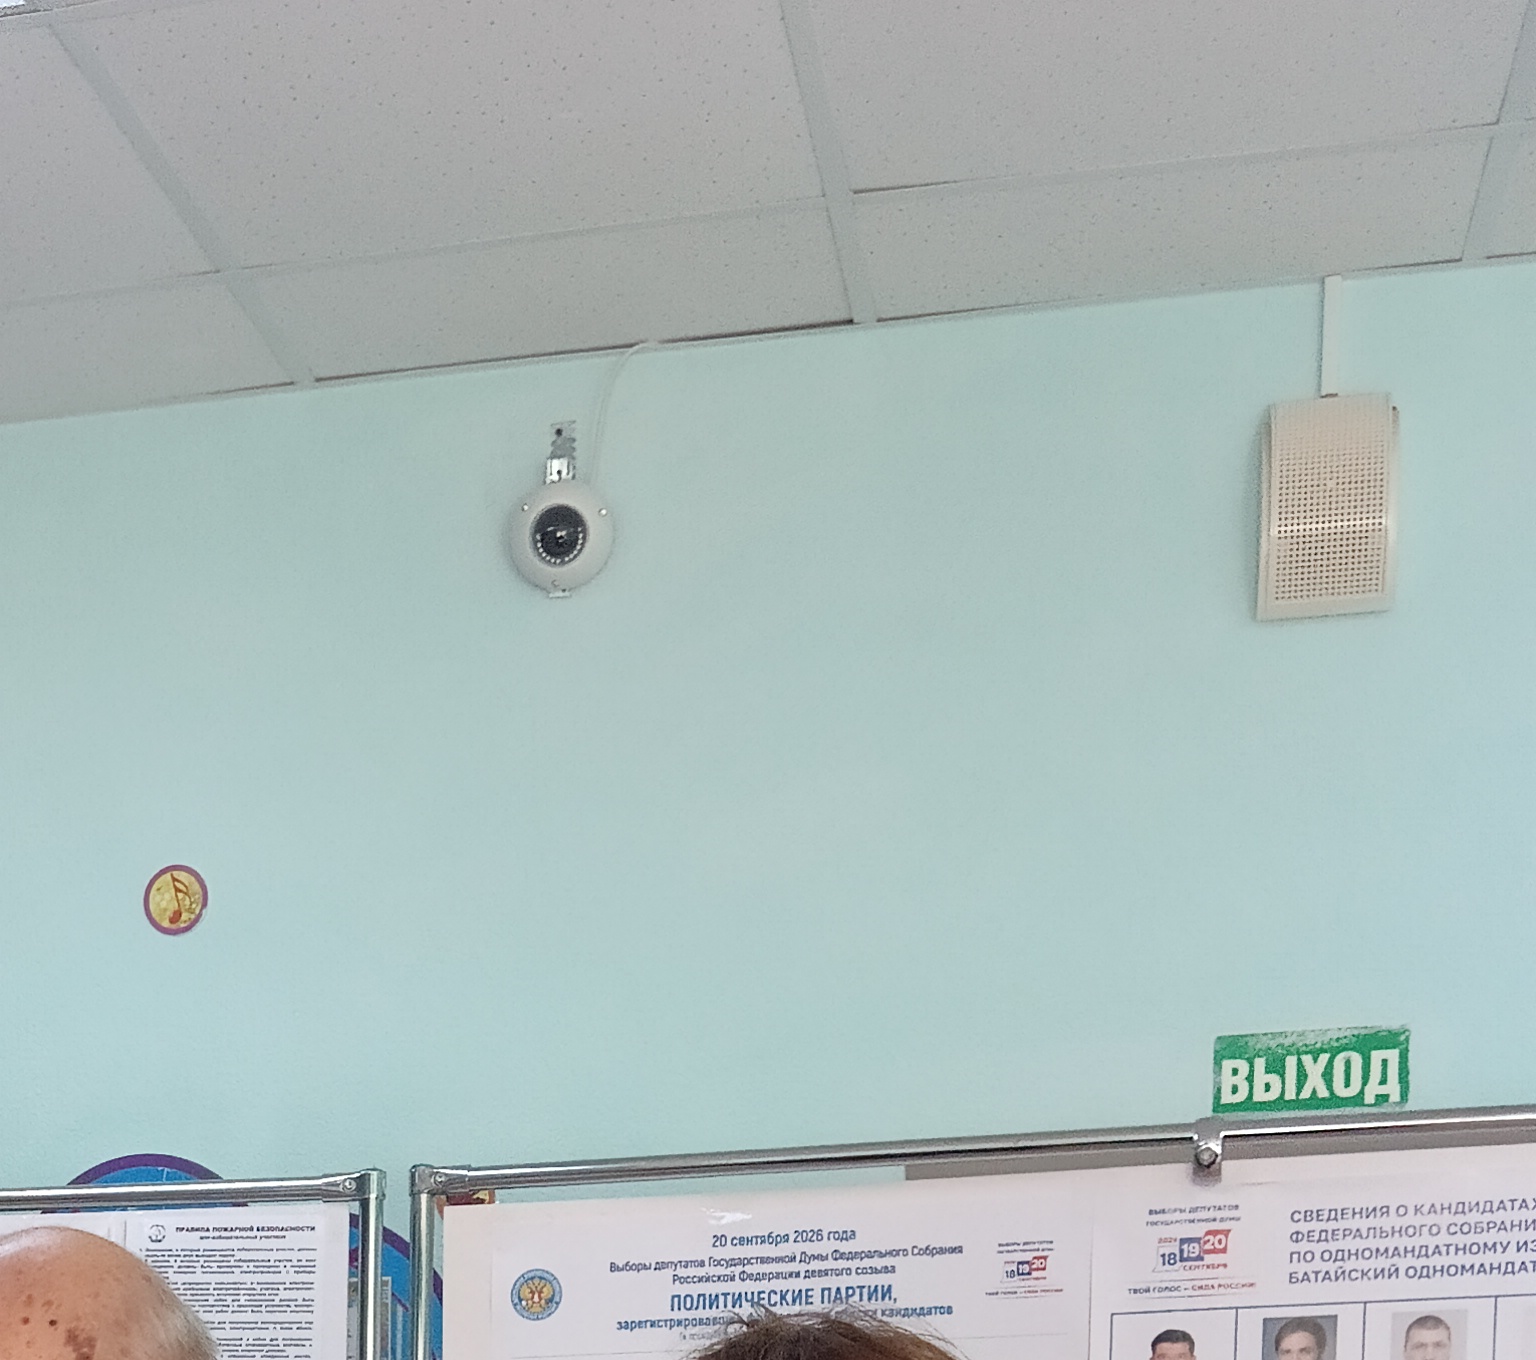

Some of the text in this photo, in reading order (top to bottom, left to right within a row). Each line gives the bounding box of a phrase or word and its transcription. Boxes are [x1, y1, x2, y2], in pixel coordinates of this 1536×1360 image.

[1220, 1048, 1401, 1105] ВЫХОД
[1290, 1204, 1391, 1224] СВЕДЕНИЯ
[1395, 1204, 1409, 1218] О
[712, 1229, 856, 1248] 20 сентября 2026 года
[1289, 1218, 1536, 1244] ФЕДЕРАЛЬНОГО СОБРАНИ
[1181, 1242, 1200, 1258] 19
[1203, 1234, 1227, 1250] 20
[1289, 1250, 1315, 1264] ПО
[1320, 1240, 1512, 1264] ОДНОМАНДАТНОМУ
[609, 1244, 964, 1273] Выборы депутатов Государственной Думы Федерального Собрания
[1031, 1259, 1046, 1268] 20
[1160, 1252, 1178, 1266] 18
[672, 1264, 896, 1285] Российской Федерации девятого созыва
[1005, 1269, 1016, 1279] 18
[1288, 1260, 1536, 1285] БАТАЙСКИЙ ОДНОМАНДАТ
[670, 1284, 898, 1312] ПОЛИТИЧЕСКИЕ ПАРТИИ,
[616, 1304, 953, 1332] зарегистрировав кандидатов
